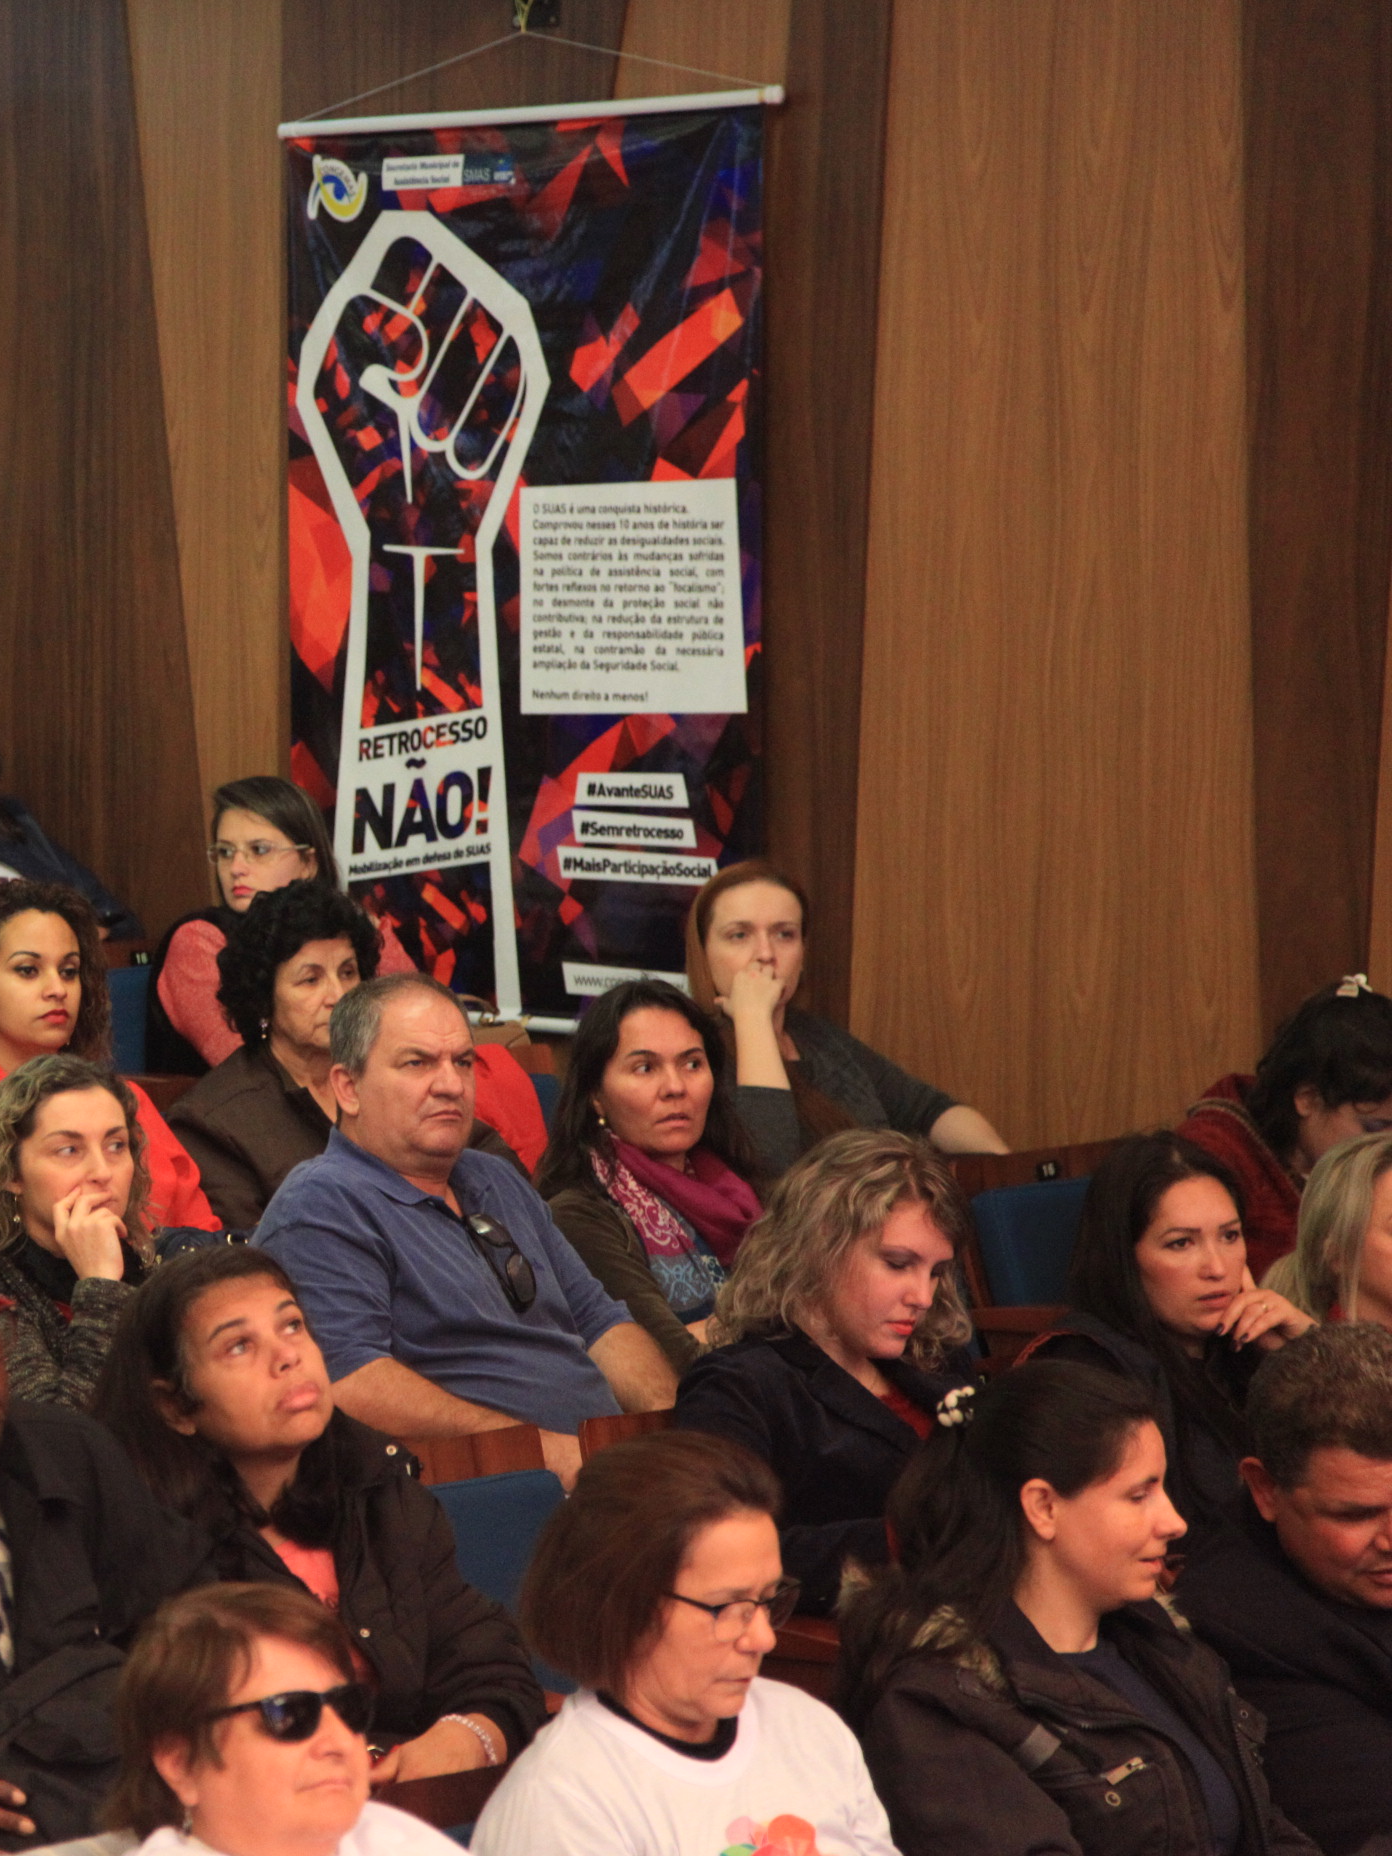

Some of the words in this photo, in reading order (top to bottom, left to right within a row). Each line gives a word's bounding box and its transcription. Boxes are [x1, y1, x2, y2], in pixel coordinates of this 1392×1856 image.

[542, 504, 566, 514] SUAS
[577, 505, 595, 514] uma
[598, 505, 641, 516] conquista
[533, 520, 583, 531] Comprovou
[586, 522, 616, 530] nesses
[632, 522, 655, 530] anos
[672, 520, 708, 530] história
[533, 537, 558, 547] capaz
[574, 536, 604, 546] reduzir
[620, 536, 690, 548] desigualdades
[533, 550, 563, 560] Somos
[568, 552, 613, 561] contrários
[634, 552, 684, 562] mudanças
[689, 551, 724, 561] sofridas
[551, 567, 583, 578] política
[608, 566, 661, 577] assistência
[533, 583, 559, 592] fortes
[562, 583, 597, 592] reflexos
[614, 584, 650, 593] retorno
[552, 598, 595, 608] desmonte
[622, 598, 665, 610] proteção
[674, 599, 700, 608] social
[708, 598, 724, 609] não
[607, 614, 646, 625] redução
[667, 615, 708, 624] estrutura
[533, 628, 561, 640] gestão
[603, 630, 683, 640] responsabilidade
[692, 630, 724, 641] pública
[594, 644, 645, 655] contramão
[676, 648, 724, 656] necessária
[532, 659, 577, 670] ampliação
[593, 660, 648, 673] Seguridade
[532, 690, 570, 700] Nenhum
[572, 690, 601, 701] direito
[612, 692, 648, 702] menos!
[359, 716, 487, 762] RETROCESSO
[587, 782, 674, 799] #AvanteSUAS
[352, 757, 492, 855] NÃO!
[580, 820, 684, 840] #Semretrocesso
[349, 857, 404, 876] Mobilização
[405, 856, 420, 867] em
[422, 850, 451, 865] defesa
[465, 842, 491, 858] SUAS
[563, 856, 712, 879] #MaisParticipaçãoSocial
